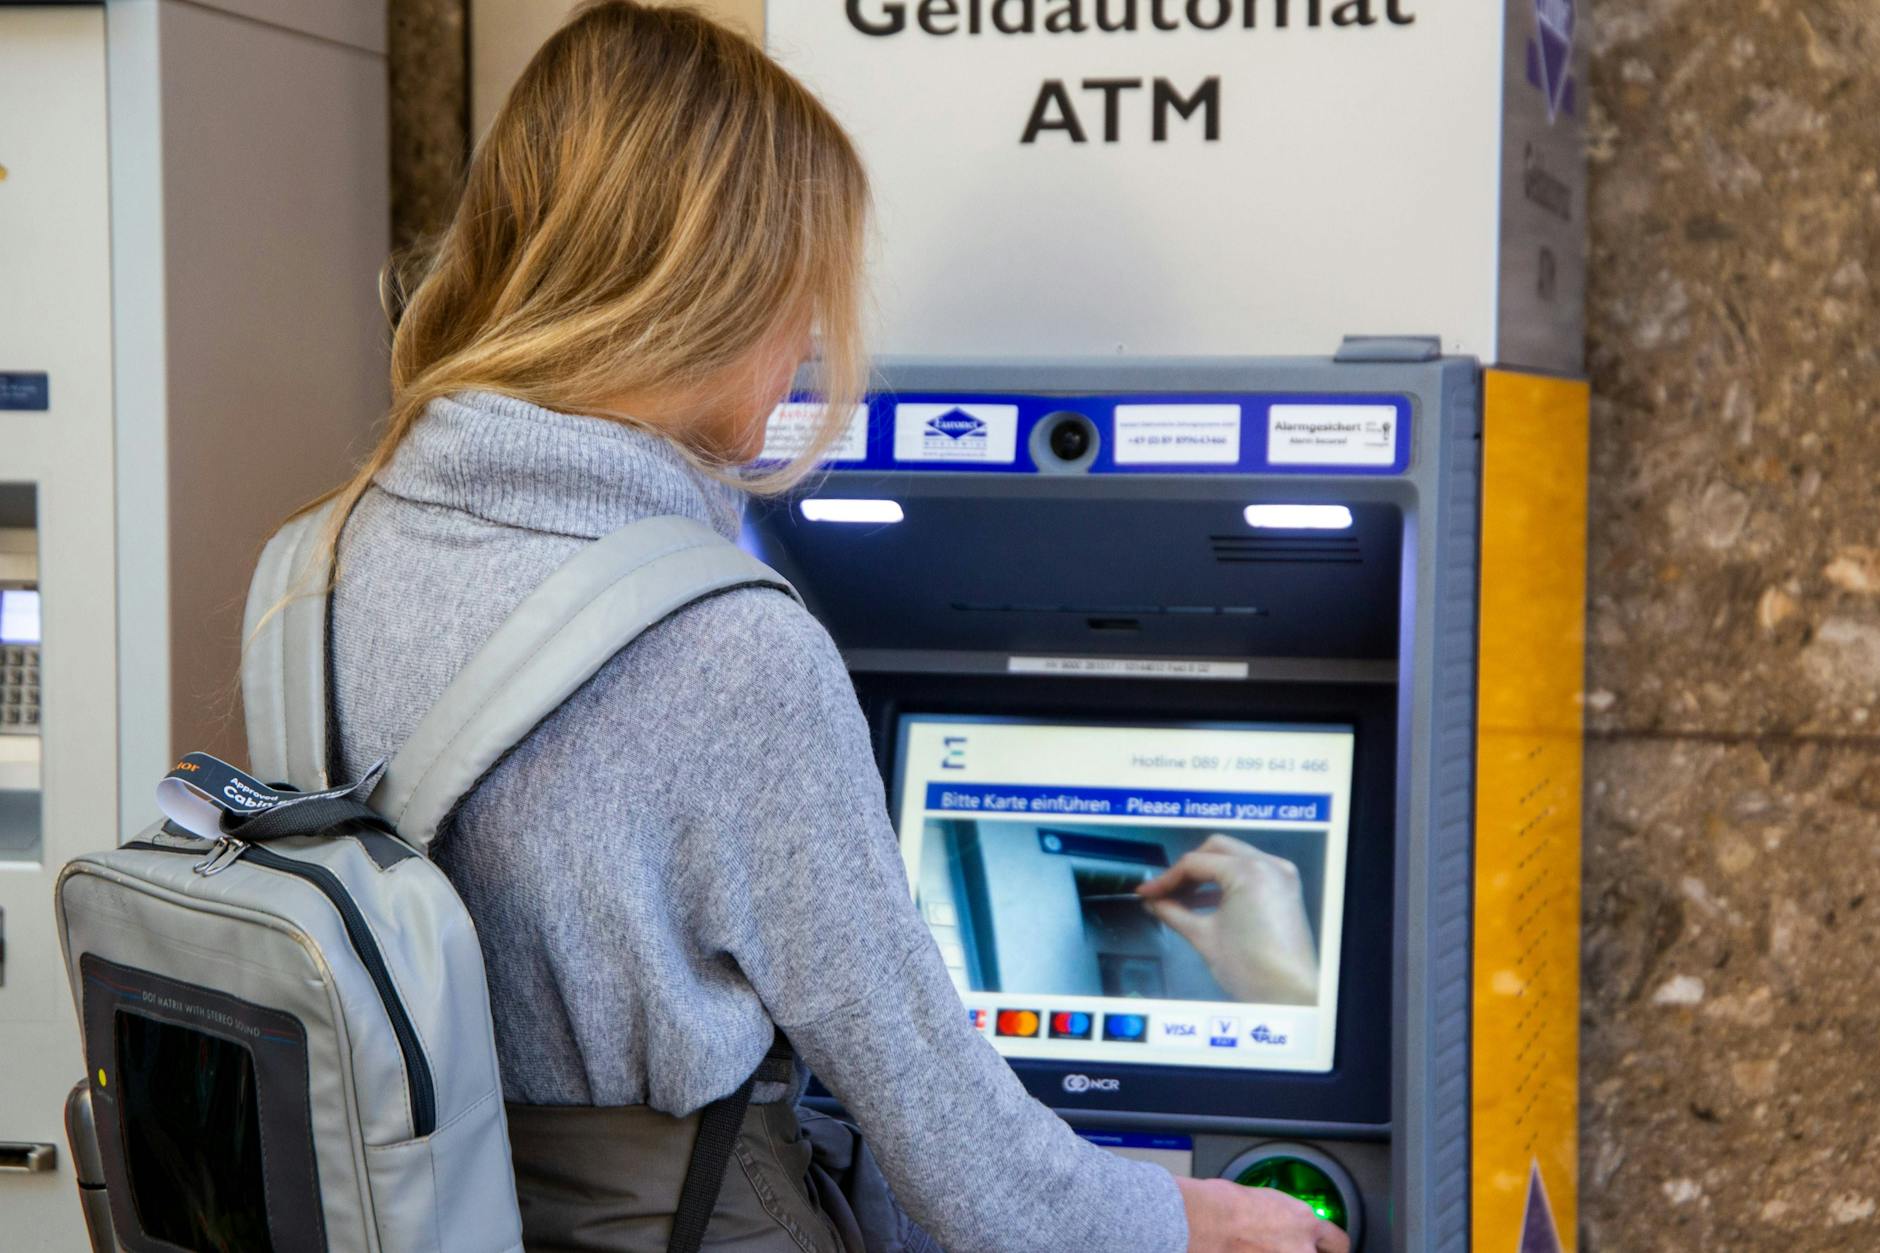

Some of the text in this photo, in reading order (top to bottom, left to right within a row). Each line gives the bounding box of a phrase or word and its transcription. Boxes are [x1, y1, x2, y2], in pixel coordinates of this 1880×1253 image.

[1020, 76, 1220, 144] ATM
[1274, 421, 1362, 433] Alarmgesichert
[1132, 754, 1185, 769] Hotline
[1191, 755, 1219, 770] 089
[1235, 756, 1263, 771] 899
[1269, 757, 1295, 771] 643
[1300, 757, 1329, 772] 466
[224, 785, 273, 808] Cabin
[230, 778, 279, 801] Approved
[942, 791, 980, 808] Bitte
[983, 793, 1028, 810] Karte
[1031, 793, 1110, 812] einführen
[1126, 797, 1181, 814] Please
[1185, 798, 1232, 816] insert
[1235, 803, 1274, 819] your
[1277, 802, 1317, 818] card
[142, 991, 261, 1038] DOT MATRIX WITH STEREO SOUND
[1163, 1022, 1197, 1036] VISA
[1219, 1020, 1232, 1034] V
[1090, 1078, 1120, 1090] NCR
